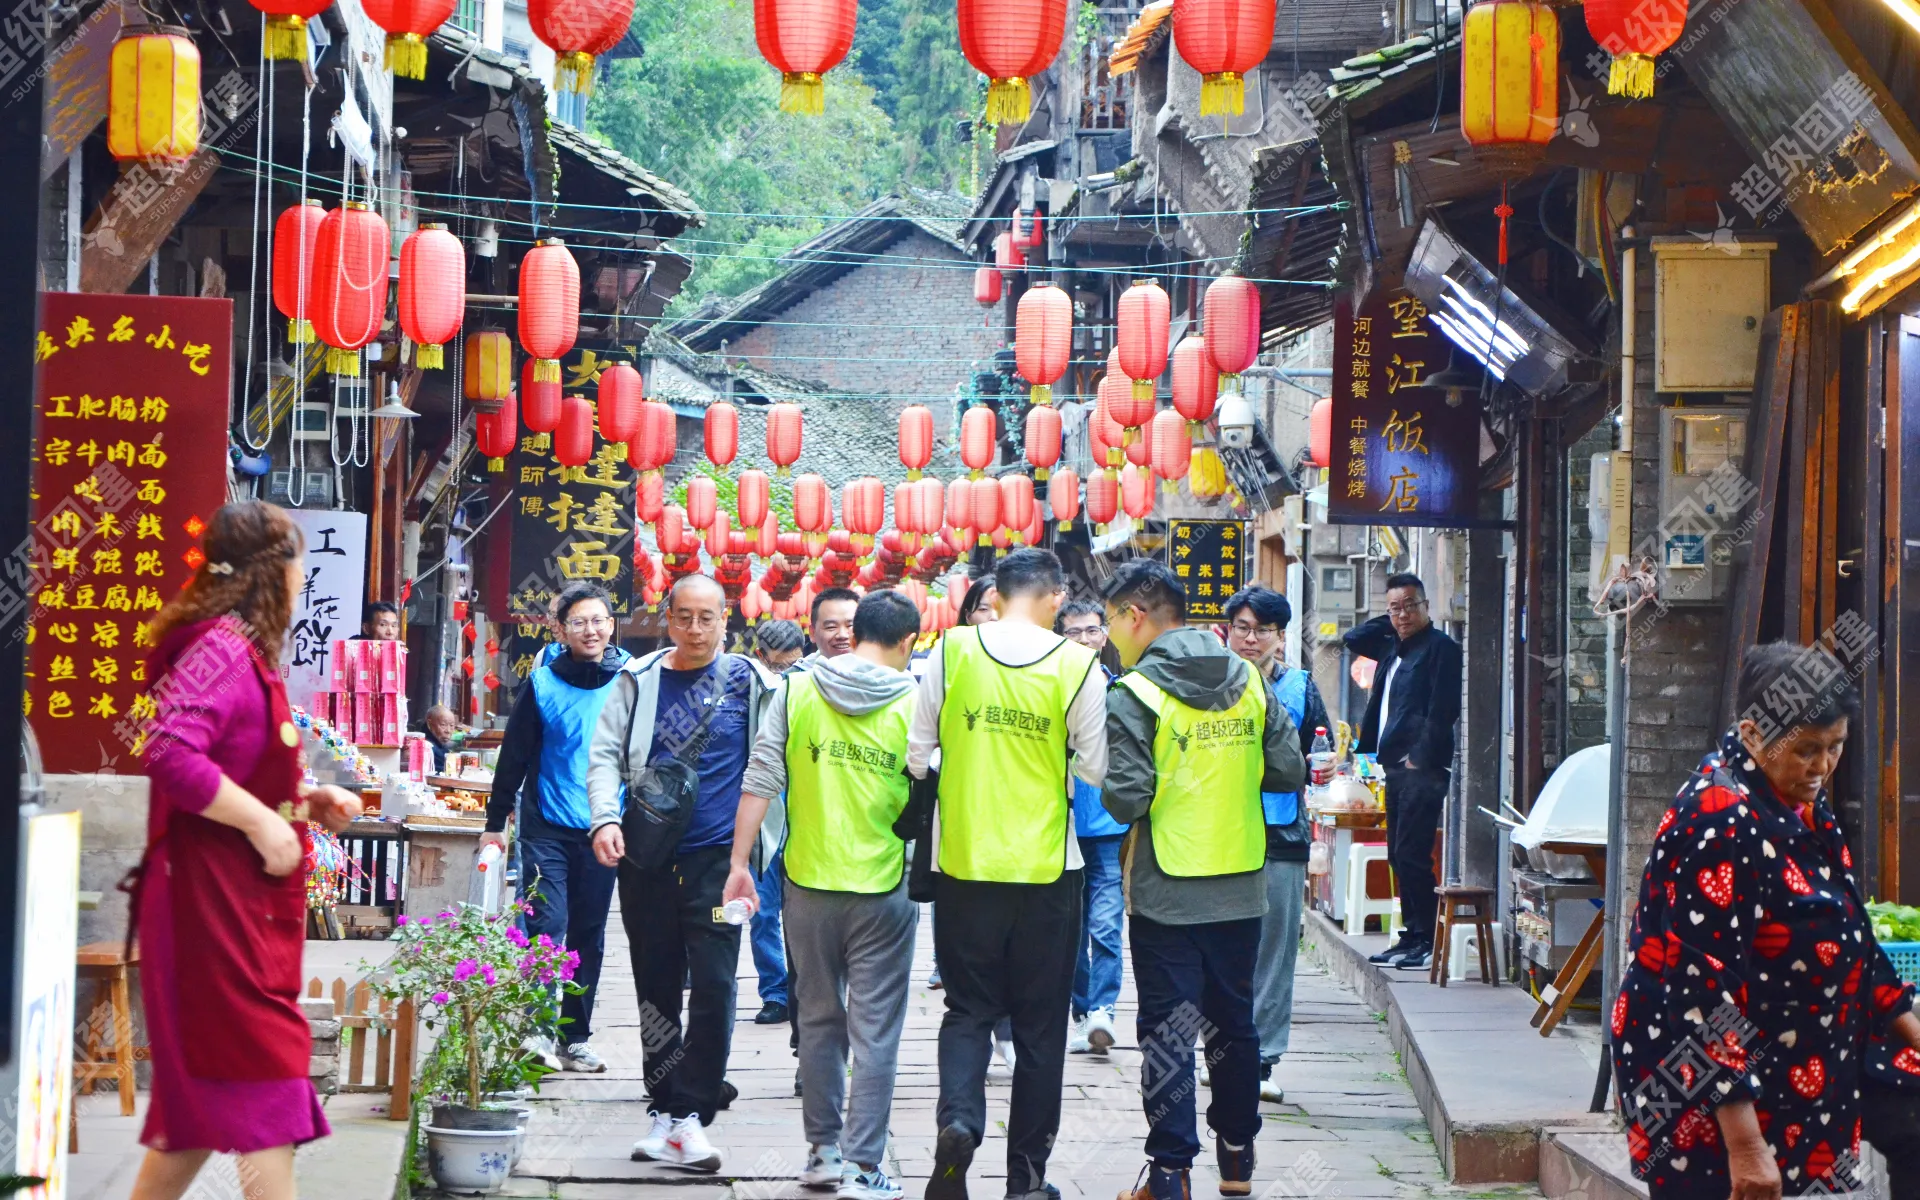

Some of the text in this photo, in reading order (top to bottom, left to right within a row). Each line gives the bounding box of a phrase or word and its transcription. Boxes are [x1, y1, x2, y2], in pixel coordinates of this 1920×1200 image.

[33, 394, 170, 423] 工肥肠粉
[1347, 317, 1373, 499] 河边就餐 中餐烧烤
[1378, 295, 1429, 513] 望江饭店
[31, 437, 168, 469] 宗牛肉面
[30, 475, 167, 505] 哒面
[29, 509, 165, 541] 肉米线
[1176, 526, 1236, 540] 奶茶
[28, 546, 165, 577] 鲜馄饨
[1176, 545, 1236, 559] 冷饮
[26, 583, 163, 612] 酥豆腐脑
[1184, 583, 1235, 596] 淇淋
[1185, 602, 1227, 616] 工冰
[984, 704, 1051, 735] 超级团建
[1195, 718, 1255, 741] 超级团建
[829, 739, 897, 770] 超级团建
